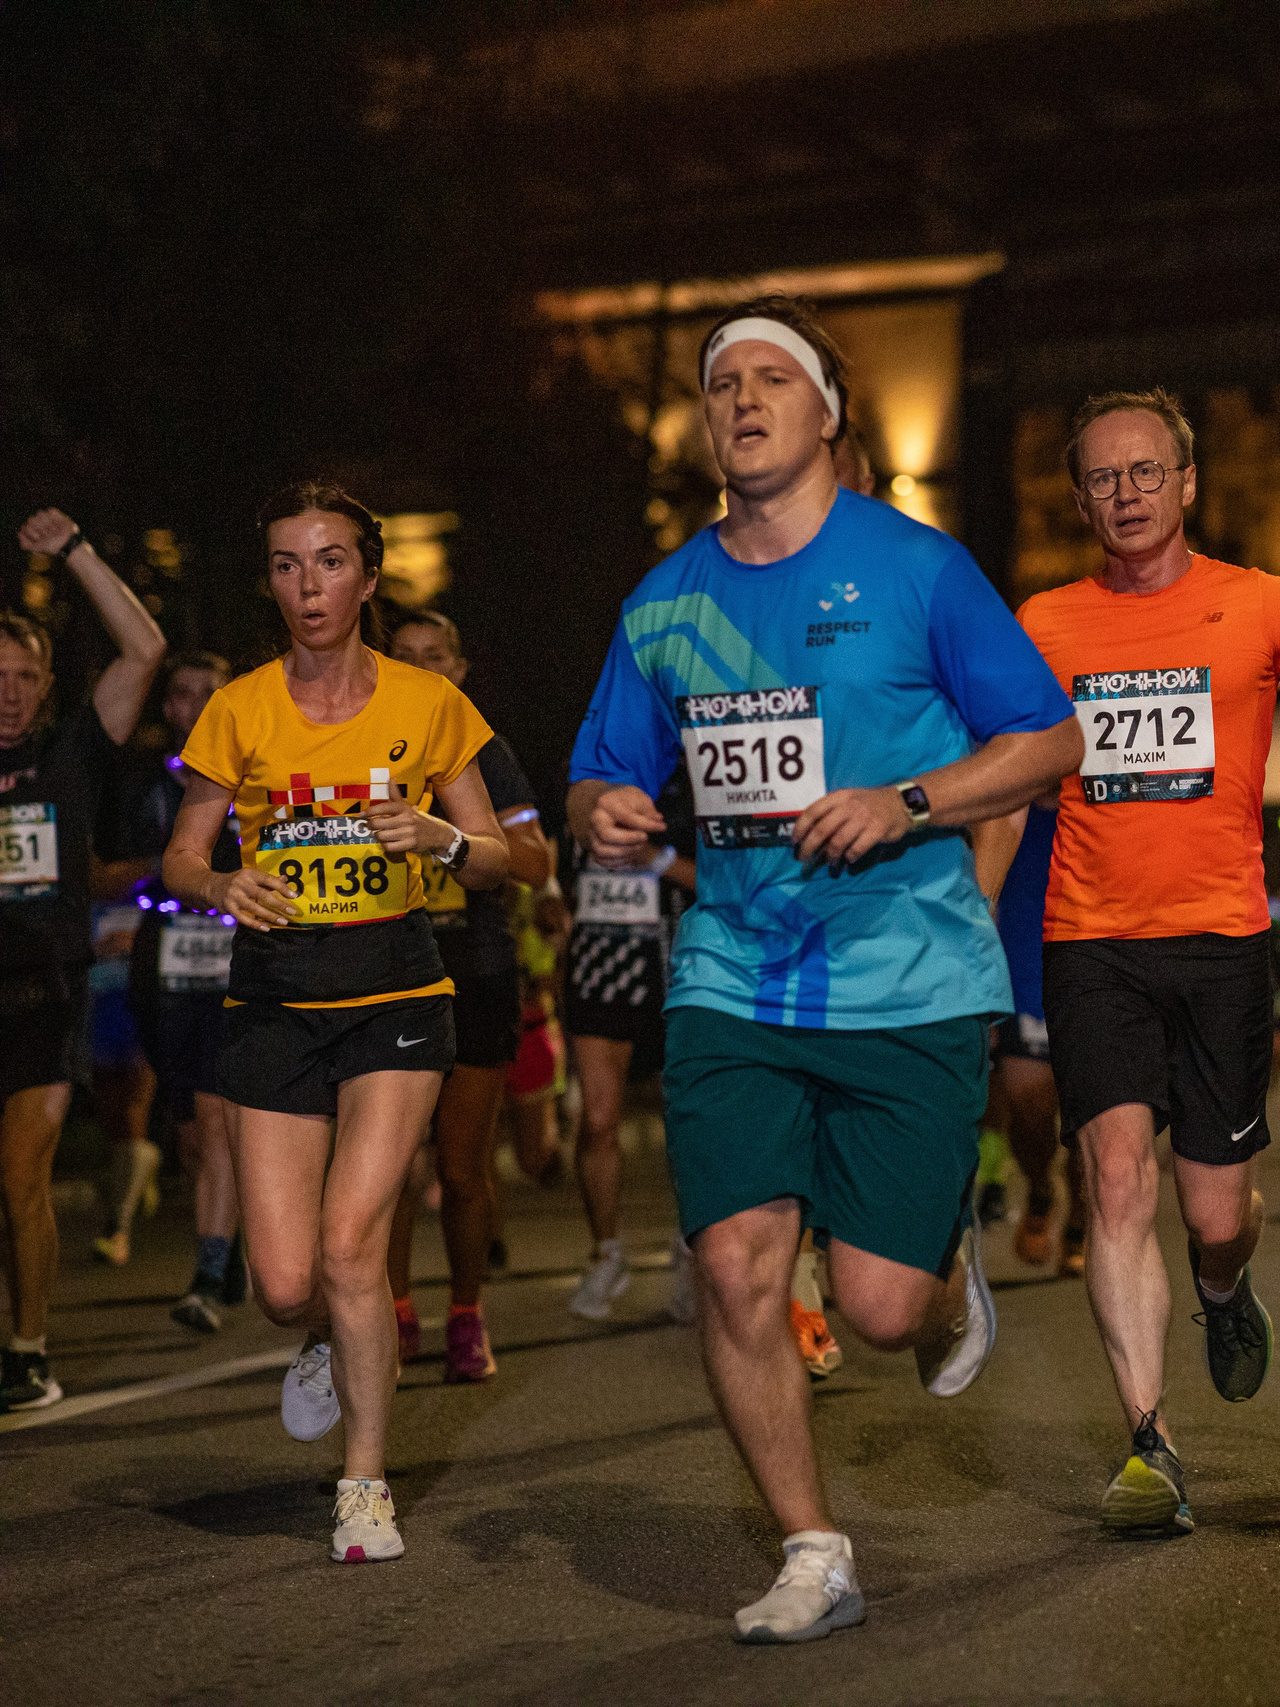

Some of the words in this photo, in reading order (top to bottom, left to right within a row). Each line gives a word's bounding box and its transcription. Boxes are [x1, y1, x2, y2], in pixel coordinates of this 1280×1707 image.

[807, 621, 871, 635] RESPECT
[805, 635, 836, 648] RUN
[1093, 706, 1197, 751] 2712
[698, 735, 804, 787] 2518
[1123, 751, 1166, 765] MAXIM
[726, 789, 777, 803] НИКИТА
[1093, 780, 1107, 801] D
[271, 816, 373, 843] НОЧНО
[707, 821, 724, 845] E
[0, 833, 39, 861] 51
[279, 856, 389, 898] 8138
[309, 902, 358, 914] МАРИЯ
